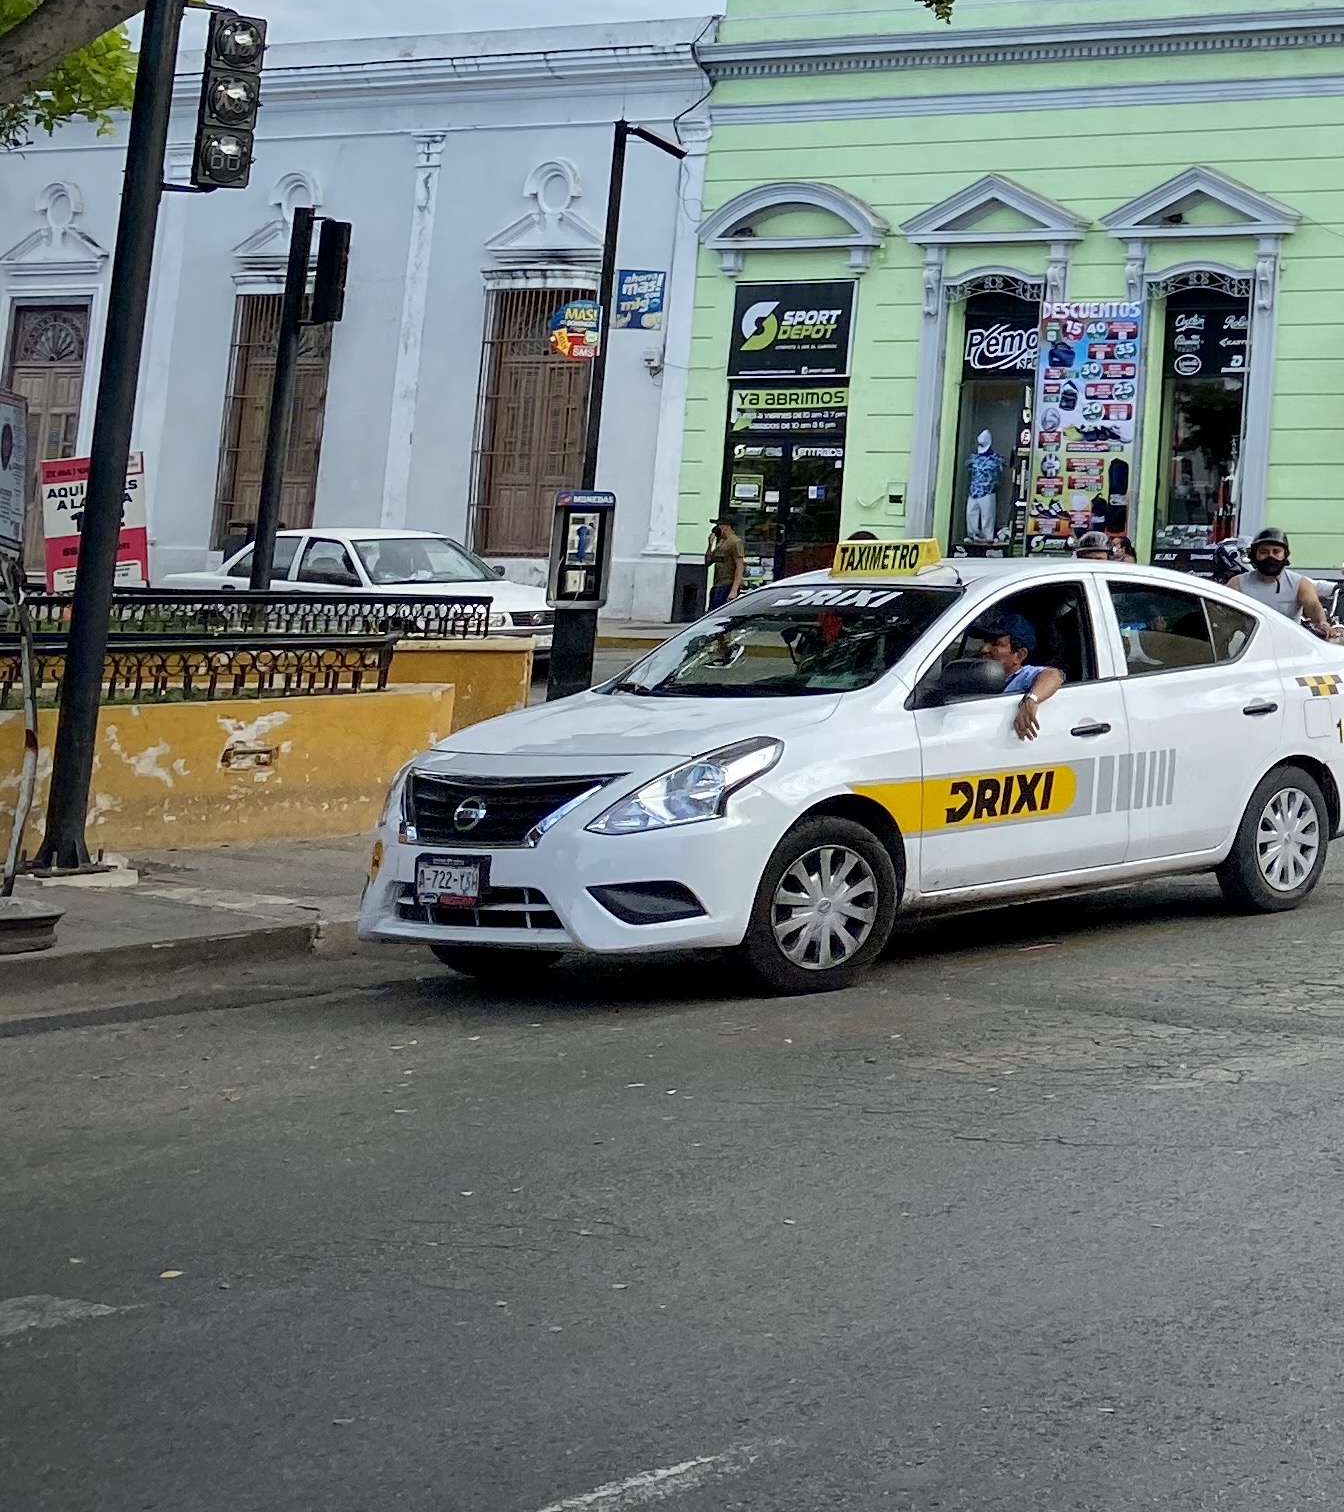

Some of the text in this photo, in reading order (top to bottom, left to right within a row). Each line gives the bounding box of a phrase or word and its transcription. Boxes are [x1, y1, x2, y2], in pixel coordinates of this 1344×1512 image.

[781, 309, 842, 325] SPORT
[1043, 301, 1141, 319] DESCUENTOS
[777, 324, 837, 340] DEPOT
[1065, 320, 1085, 336] 15
[1087, 322, 1106, 335] 40
[572, 345, 595, 356] SMS
[1116, 343, 1135, 355] 35
[1082, 364, 1099, 376] 30
[1115, 385, 1134, 397] 25
[1083, 405, 1101, 416] 20
[57, 500, 67, 510] A
[573, 495, 614, 504] MONEDAS
[840, 544, 919, 572] TAXIMETRO
[771, 589, 904, 608] DRIXI
[945, 771, 1055, 824] DRIXI
